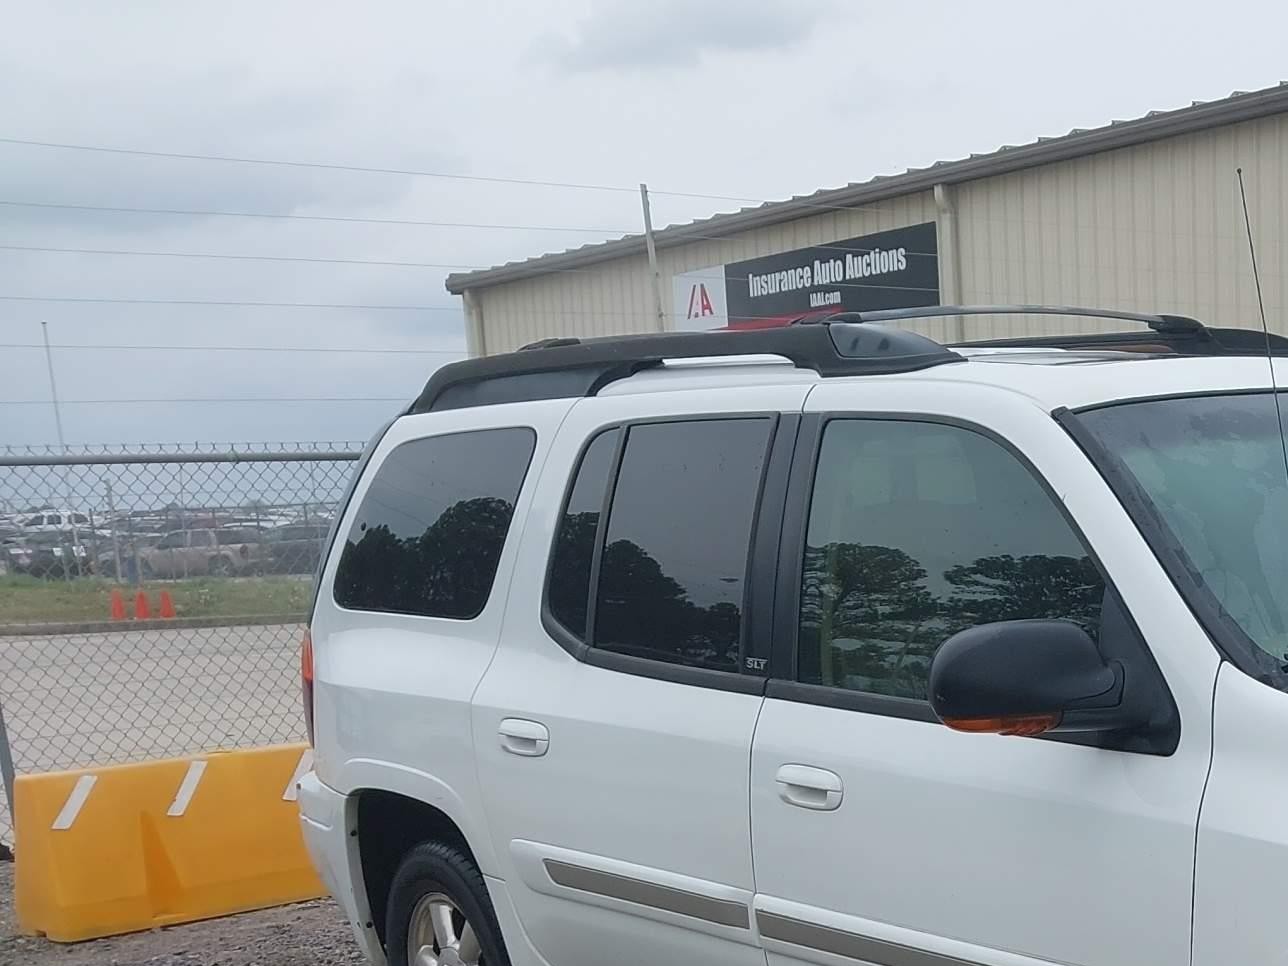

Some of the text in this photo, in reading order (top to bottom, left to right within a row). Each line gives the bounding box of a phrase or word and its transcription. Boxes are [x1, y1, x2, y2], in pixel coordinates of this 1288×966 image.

[749, 247, 906, 298] Insurance Auto Auctions
[746, 658, 768, 670] SLT
